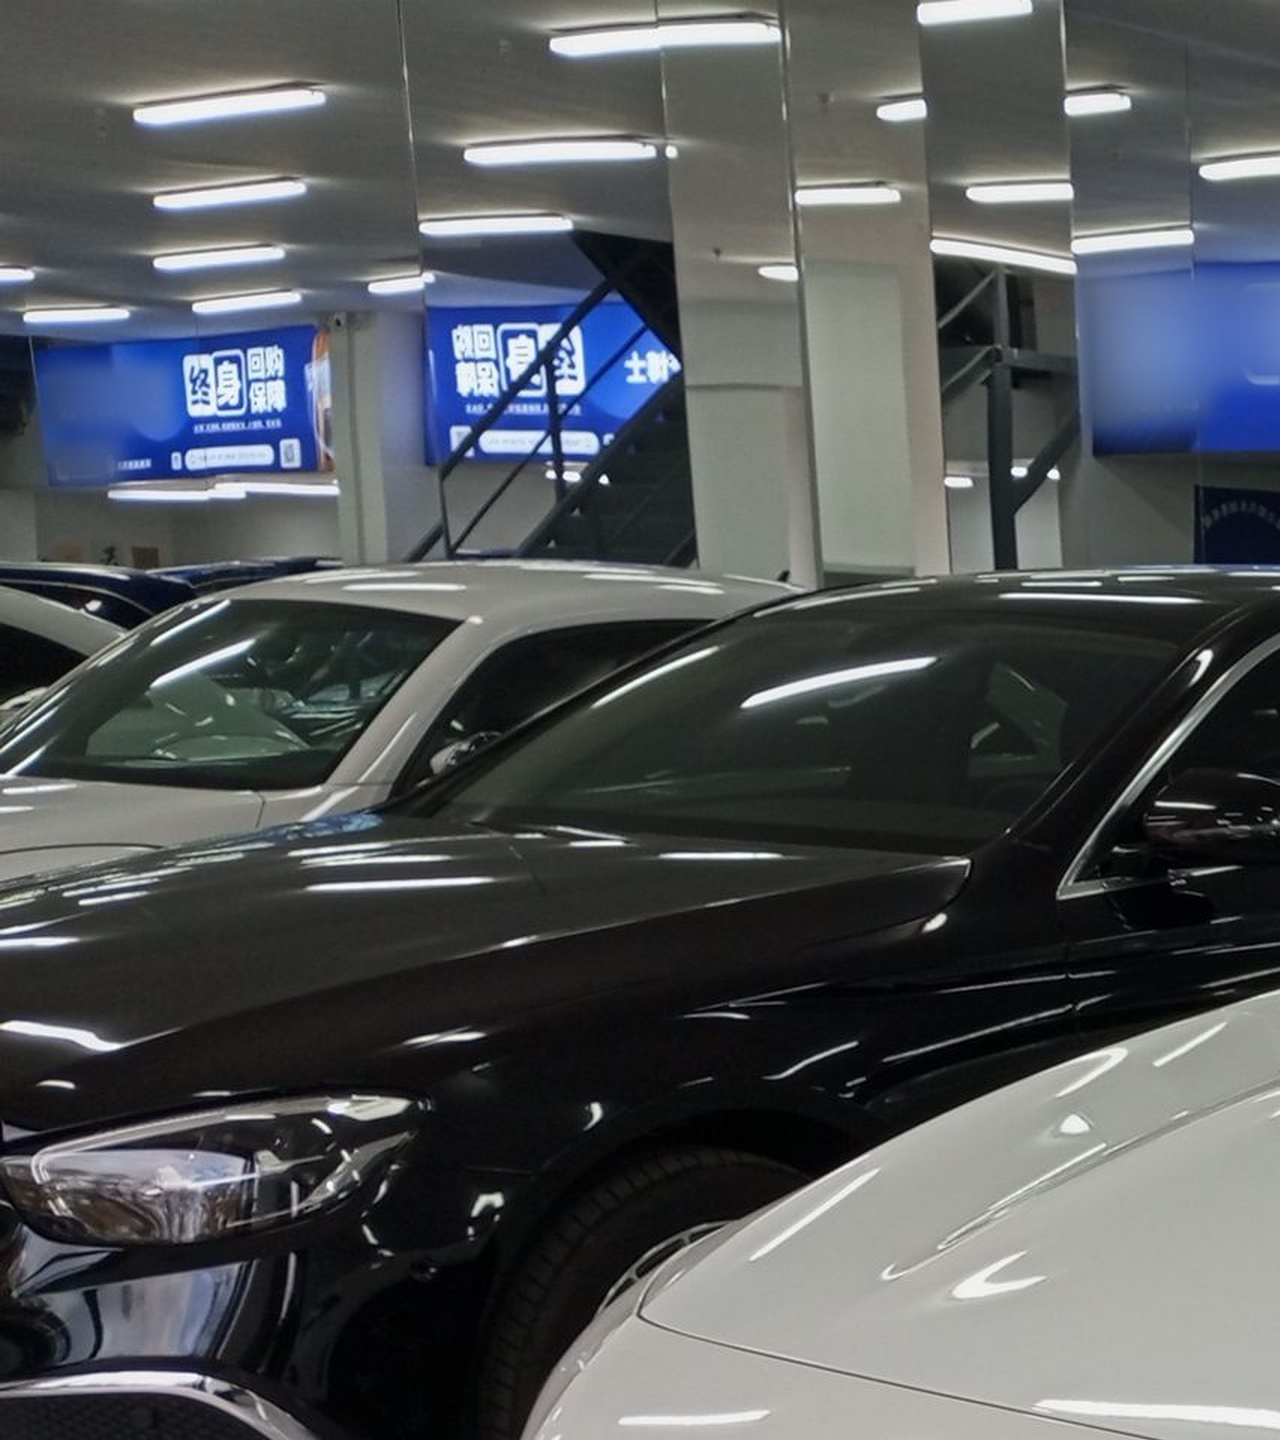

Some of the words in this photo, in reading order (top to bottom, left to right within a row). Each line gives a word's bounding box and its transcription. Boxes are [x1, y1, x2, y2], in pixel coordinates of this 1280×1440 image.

[247, 345, 285, 380] 回购
[186, 355, 245, 412] 终身
[249, 379, 287, 413] 保障
